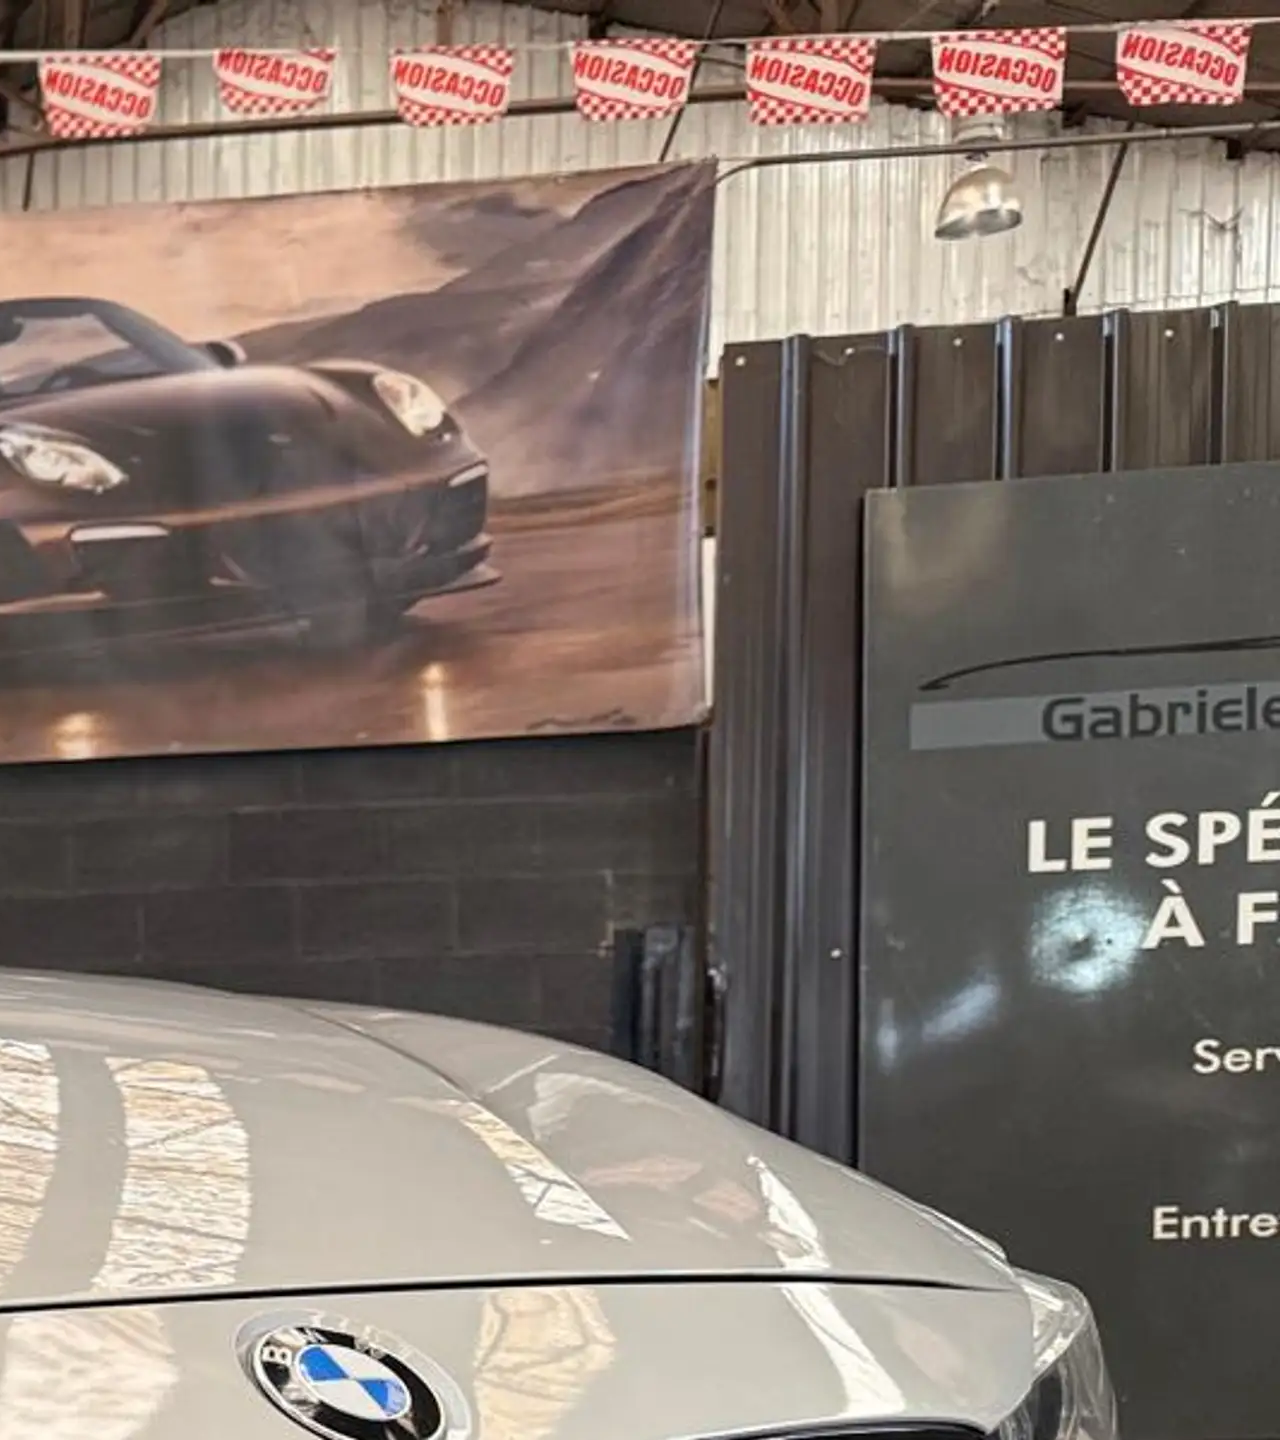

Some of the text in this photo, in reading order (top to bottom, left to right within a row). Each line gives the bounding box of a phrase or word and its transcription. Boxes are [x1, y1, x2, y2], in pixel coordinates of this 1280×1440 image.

[1028, 791, 1280, 872] LE SPÉ
[1141, 878, 1206, 949] À
